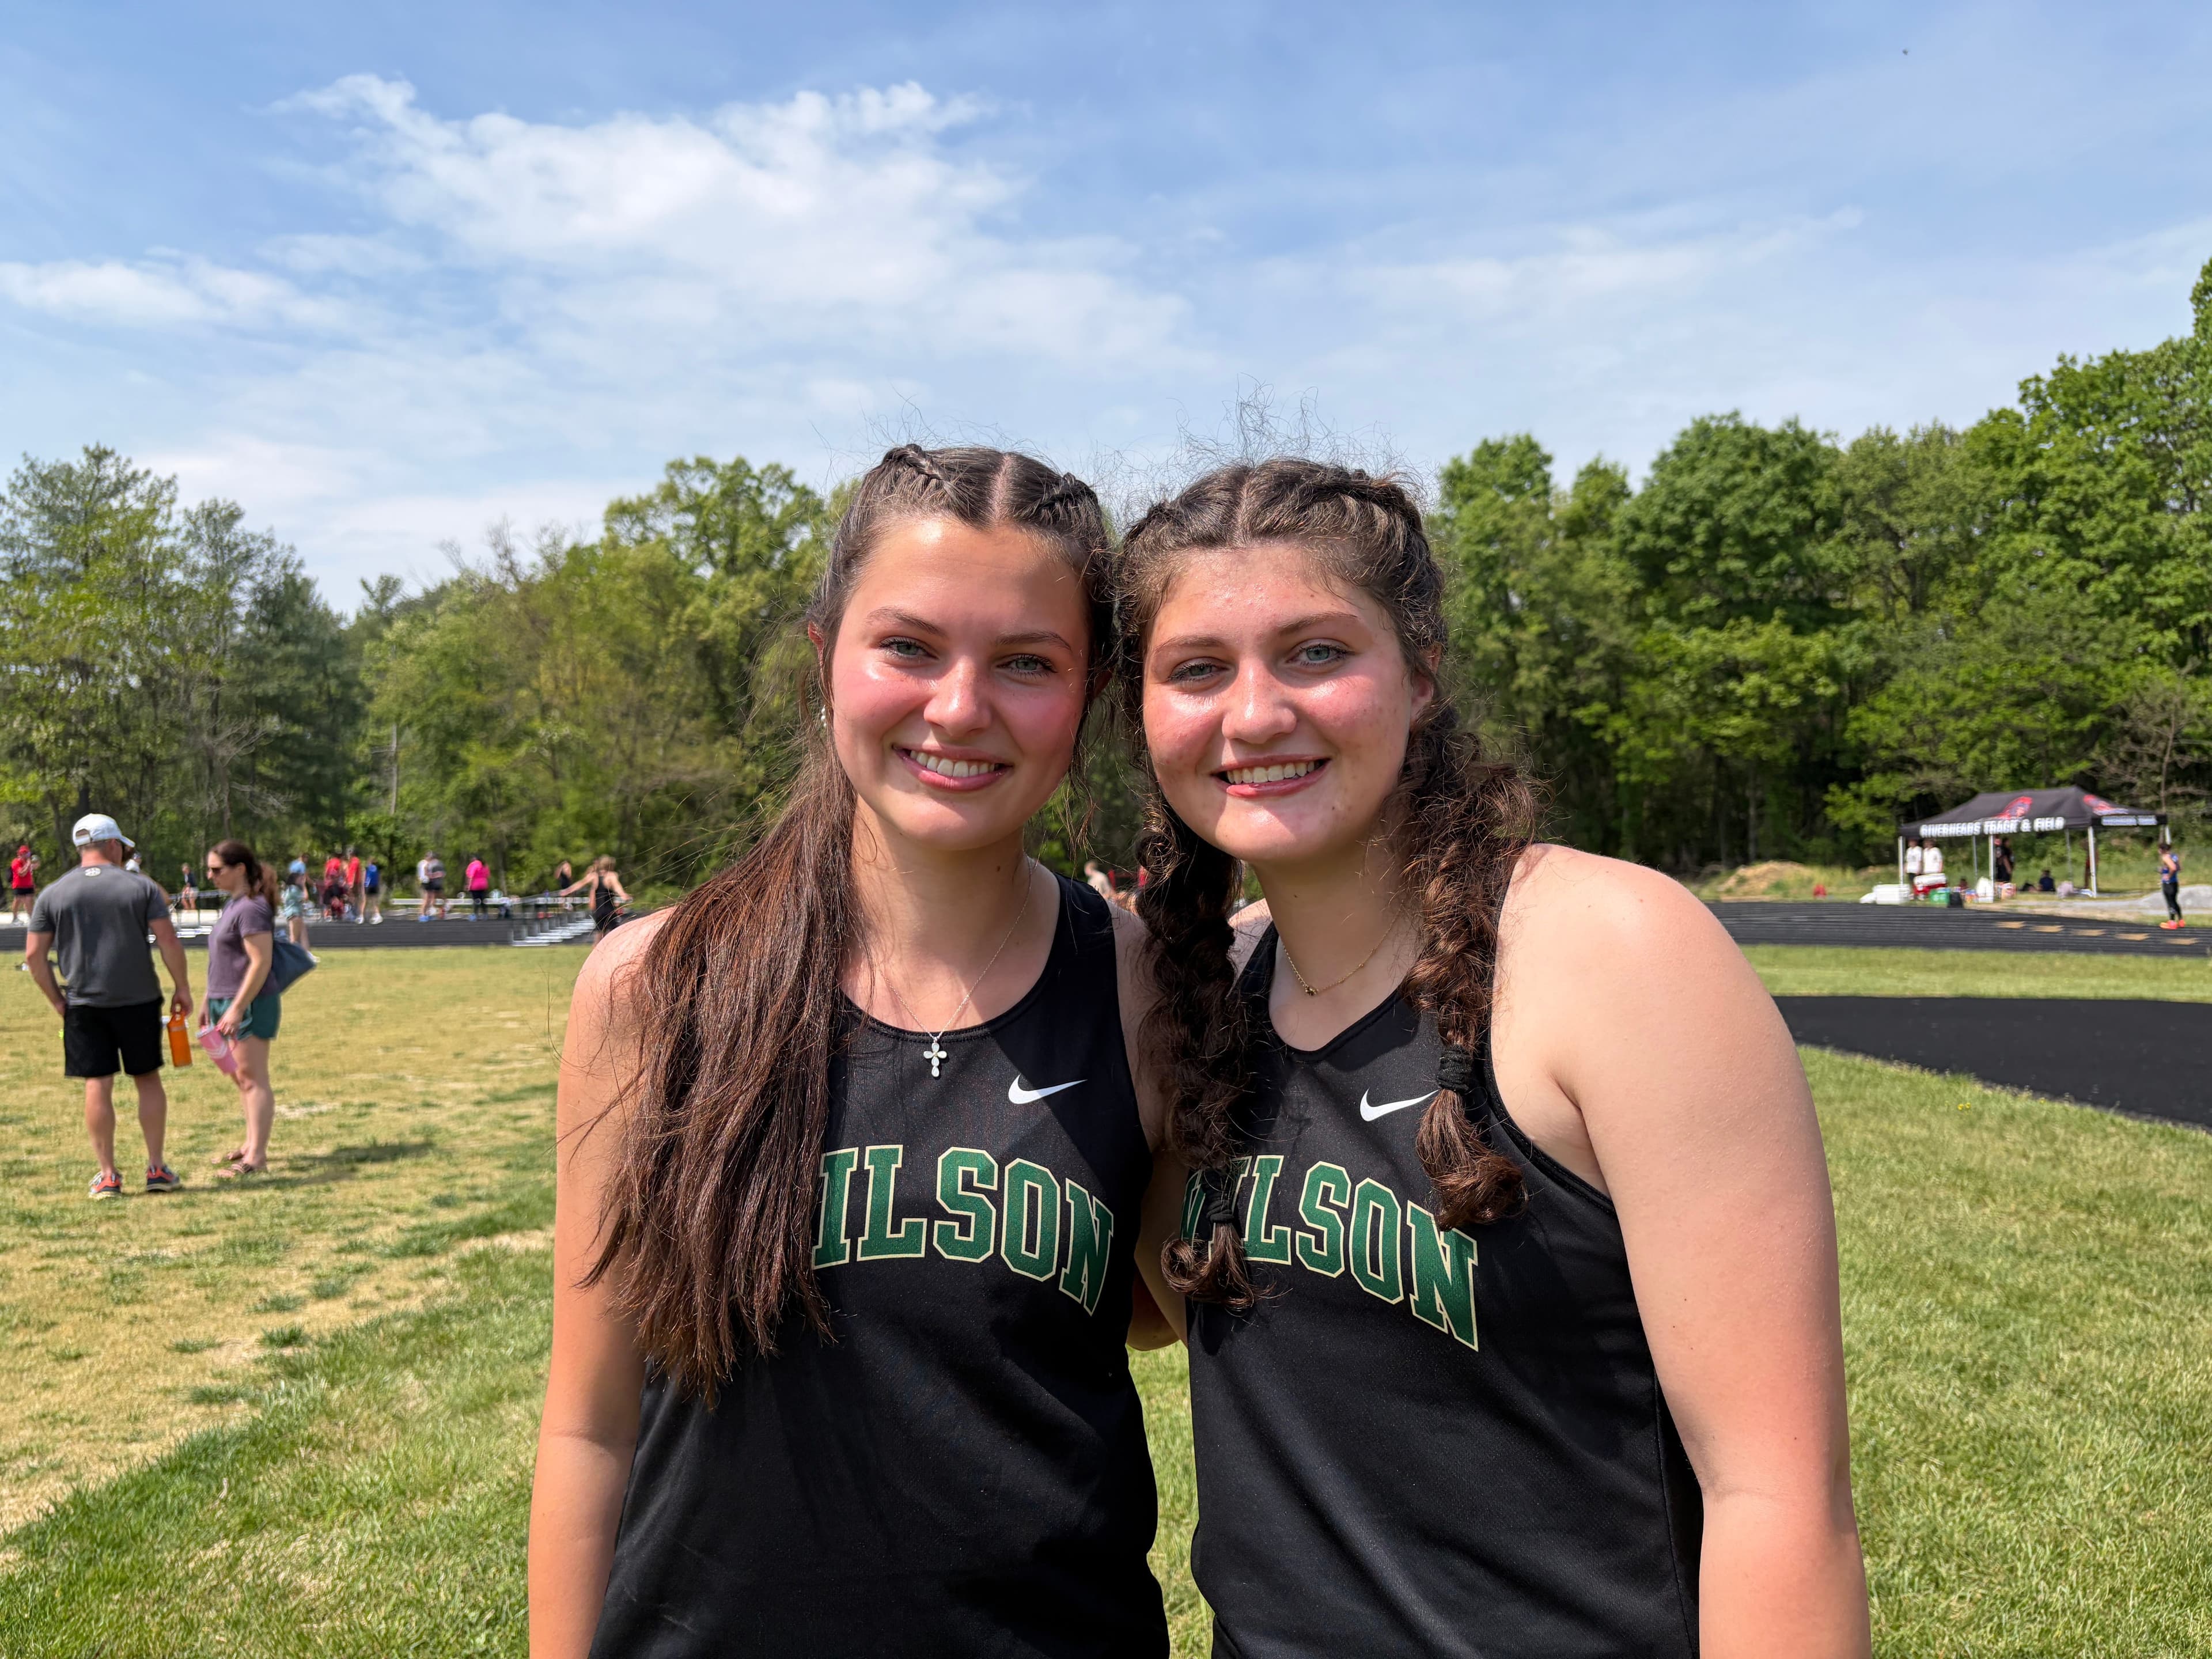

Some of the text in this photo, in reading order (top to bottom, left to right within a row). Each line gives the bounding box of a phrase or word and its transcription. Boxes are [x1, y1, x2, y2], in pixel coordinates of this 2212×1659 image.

[1983, 819, 2018, 835] TRACK
[2020, 819, 2031, 832] &
[2033, 817, 2065, 831] FIELD
[812, 1145, 1113, 1316] ILSON
